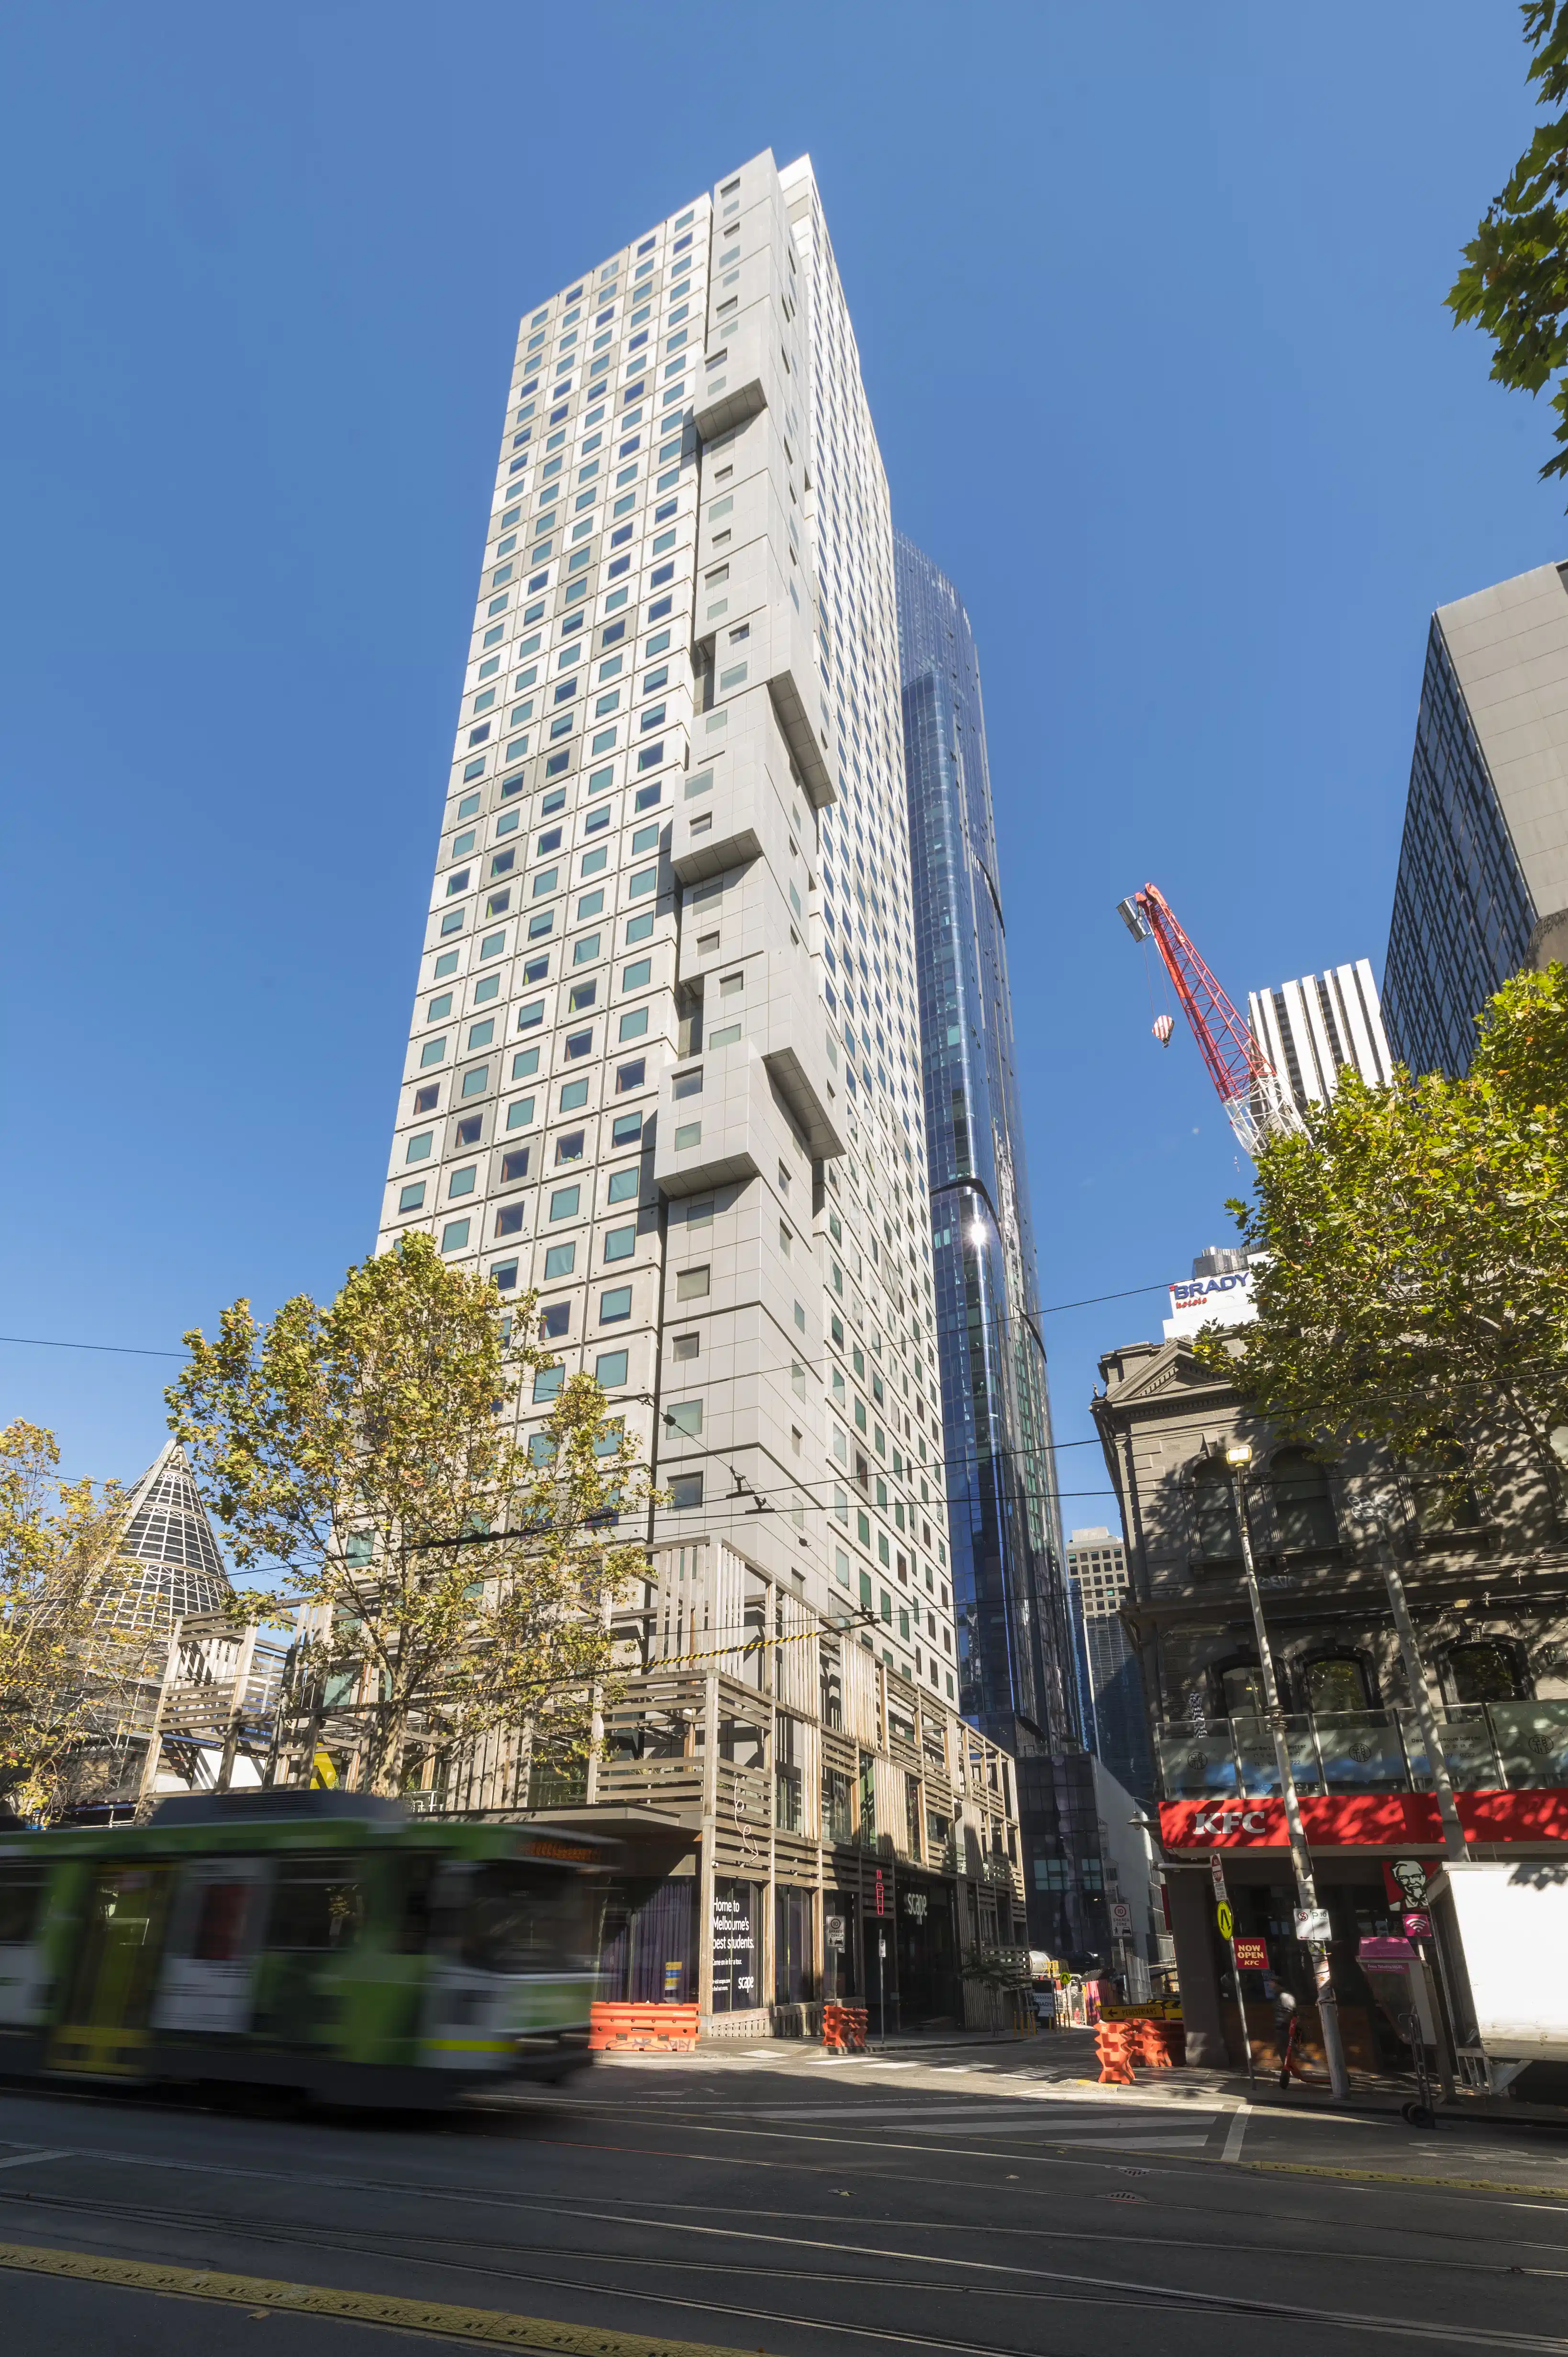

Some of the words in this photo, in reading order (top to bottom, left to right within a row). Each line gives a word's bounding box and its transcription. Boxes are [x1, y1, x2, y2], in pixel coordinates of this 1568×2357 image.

[1175, 1272, 1249, 1300] BRADY
[1176, 1297, 1207, 1309] hotels
[1192, 1811, 1266, 1834] KFC
[713, 1897, 732, 1912] Home
[733, 1900, 740, 1912] to
[908, 1893, 927, 1925] scape
[713, 1915, 749, 1931] Melbourne's
[727, 1934, 755, 1949] students.
[738, 1976, 754, 1993] scape
